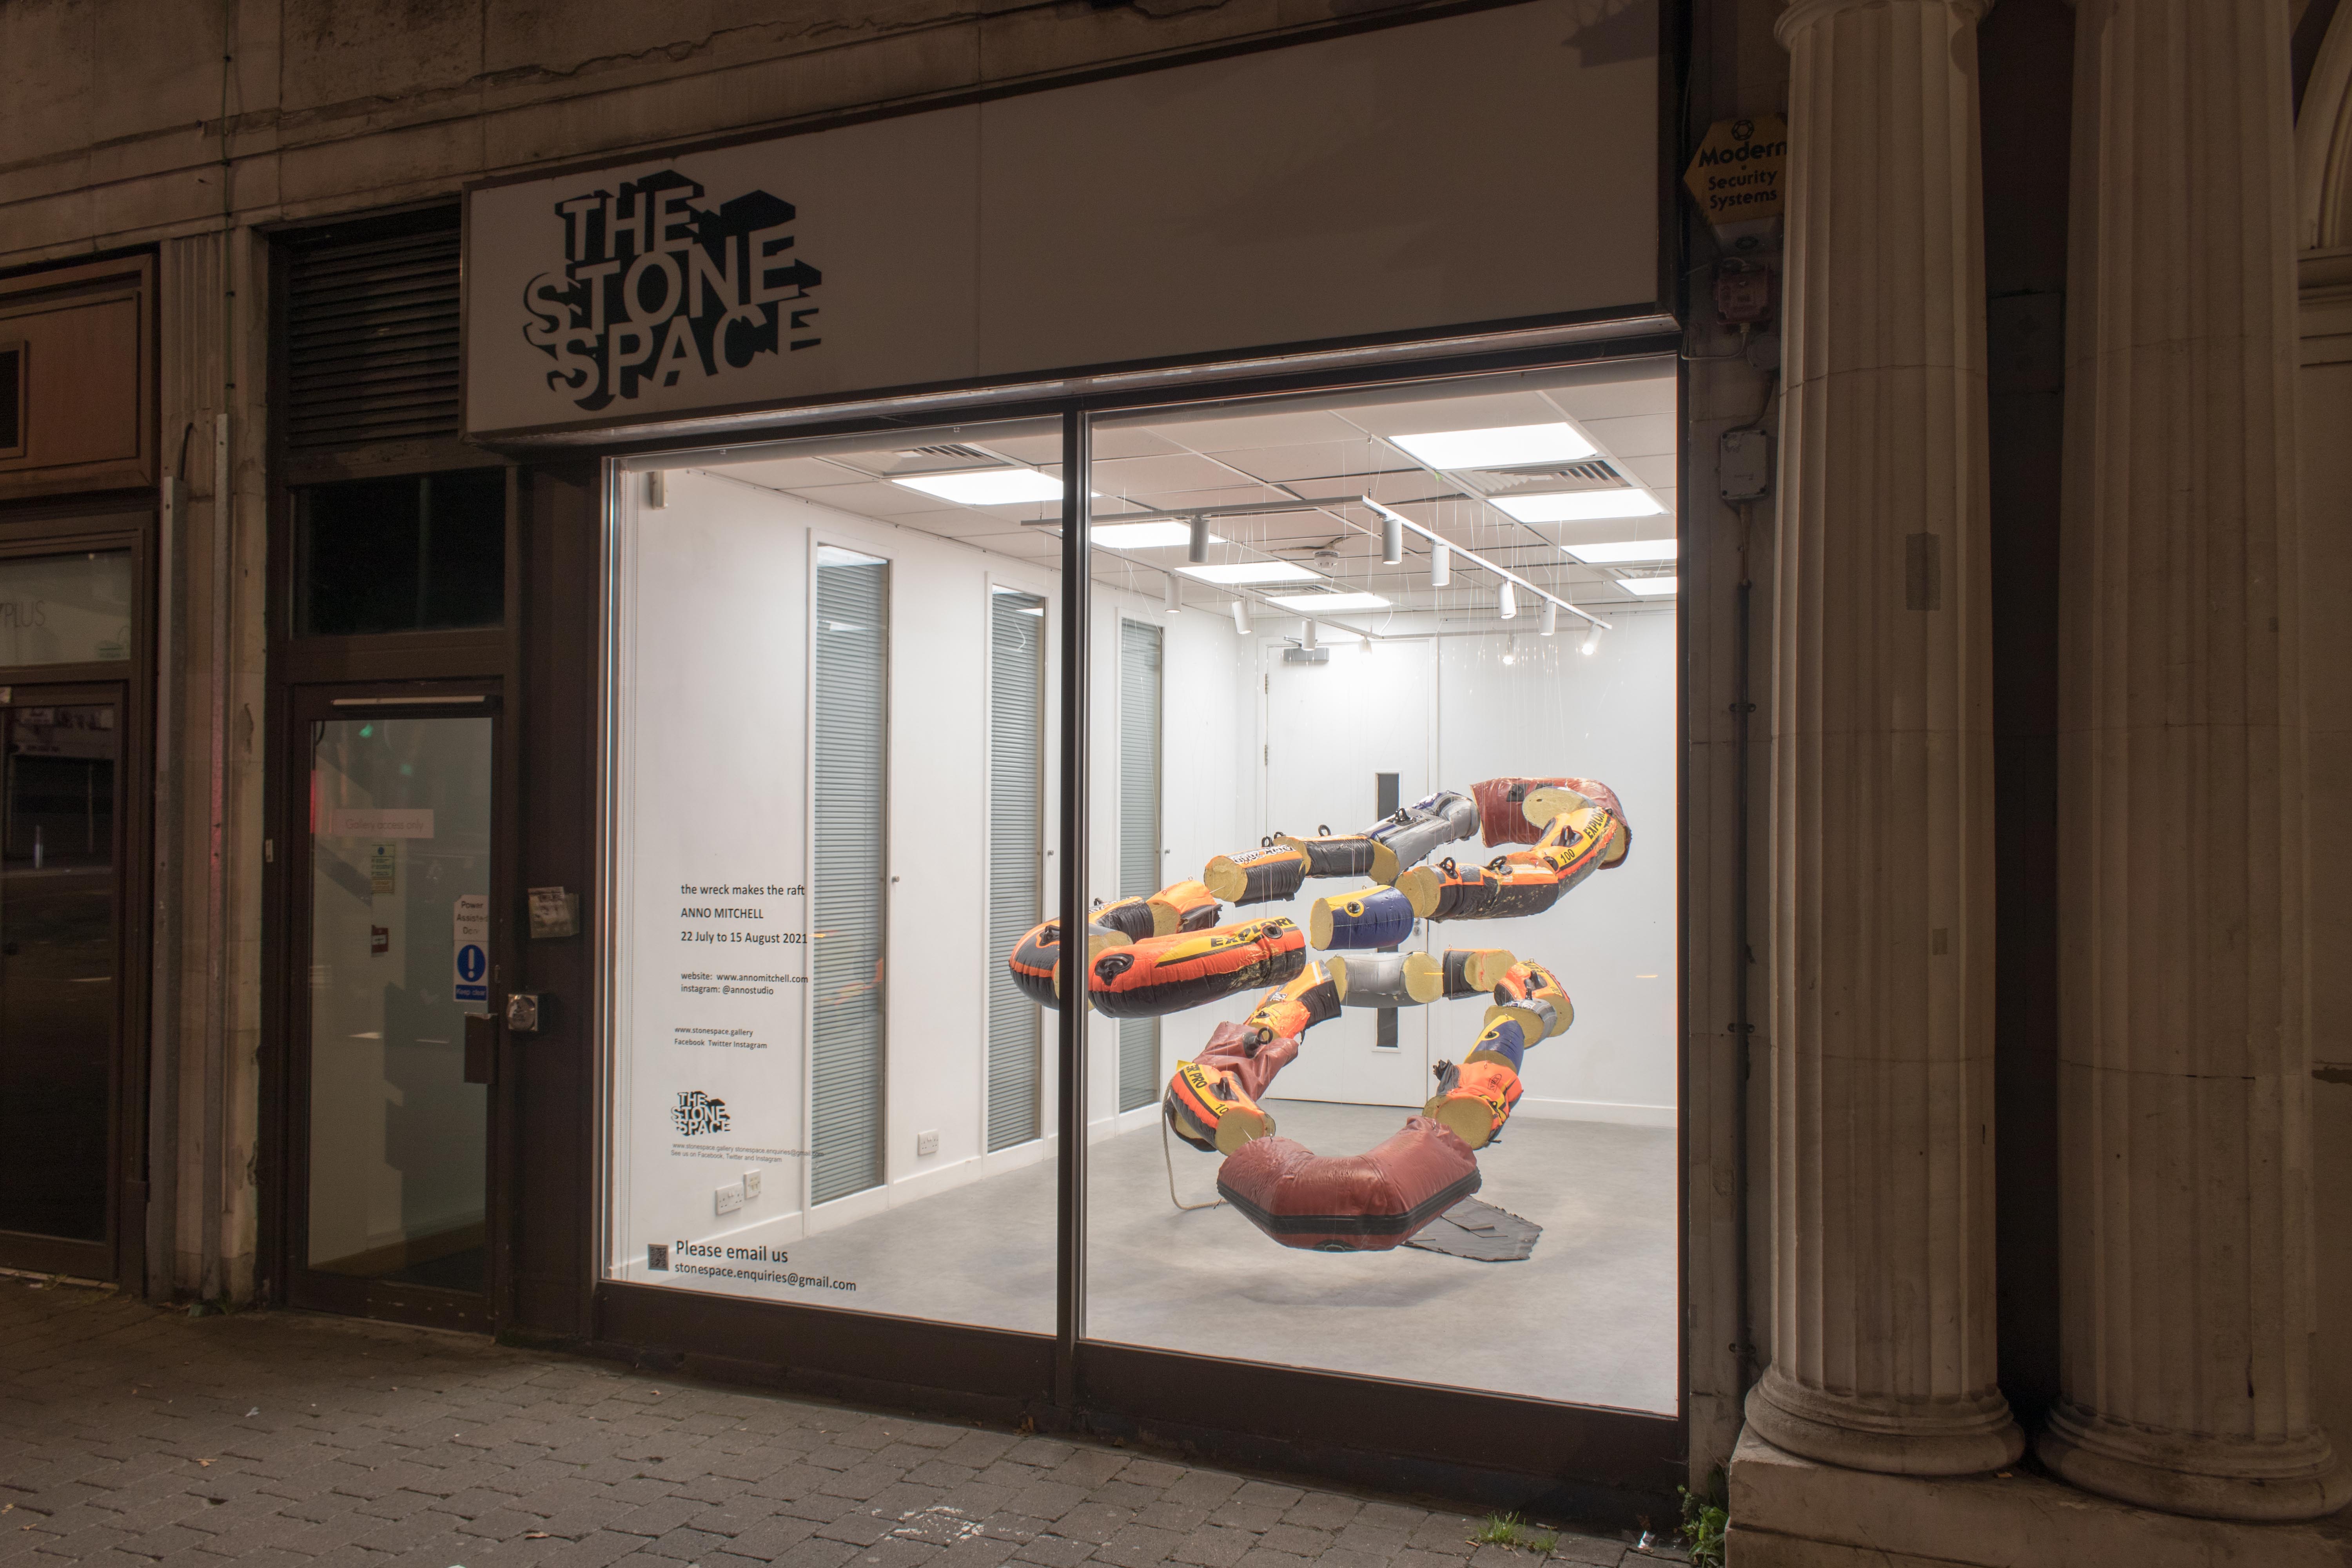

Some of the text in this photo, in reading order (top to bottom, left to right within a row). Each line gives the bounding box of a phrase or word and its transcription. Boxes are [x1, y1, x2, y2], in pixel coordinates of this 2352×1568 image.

[1699, 140, 1787, 167] Modern
[1708, 170, 1778, 191] Security
[1710, 189, 1777, 211] Systems
[555, 172, 704, 263] THE
[524, 225, 808, 345] STONE
[547, 299, 821, 406] SPACE
[0, 600, 46, 628] PLUS
[345, 817, 424, 832] Gallery access only
[1583, 809, 1606, 840] EXPLOR
[1561, 849, 1575, 863] 100
[681, 884, 805, 895] the wreck makes the raft
[461, 900, 483, 909] Power
[681, 908, 764, 918] ANNO MITCHELL
[681, 931, 808, 945] 22 July to 15 August 2021
[681, 972, 808, 983] website: www.annomitchell.com
[681, 984, 774, 995] instagram: @annostudio
[674, 1027, 753, 1038] www.stonespace.gallery
[733, 1041, 767, 1050] Instagram
[1189, 1072, 1207, 1088] PRO
[677, 1090, 708, 1107] THE
[671, 1105, 728, 1122] STONE
[676, 1120, 731, 1136] SPACE
[672, 1143, 824, 1157] www.stonespace.gallery stonespace.enquiries@gmail.com
[676, 1240, 788, 1263] Please email us
[674, 1262, 857, 1291] stonespace.enquiries@gmail.com
